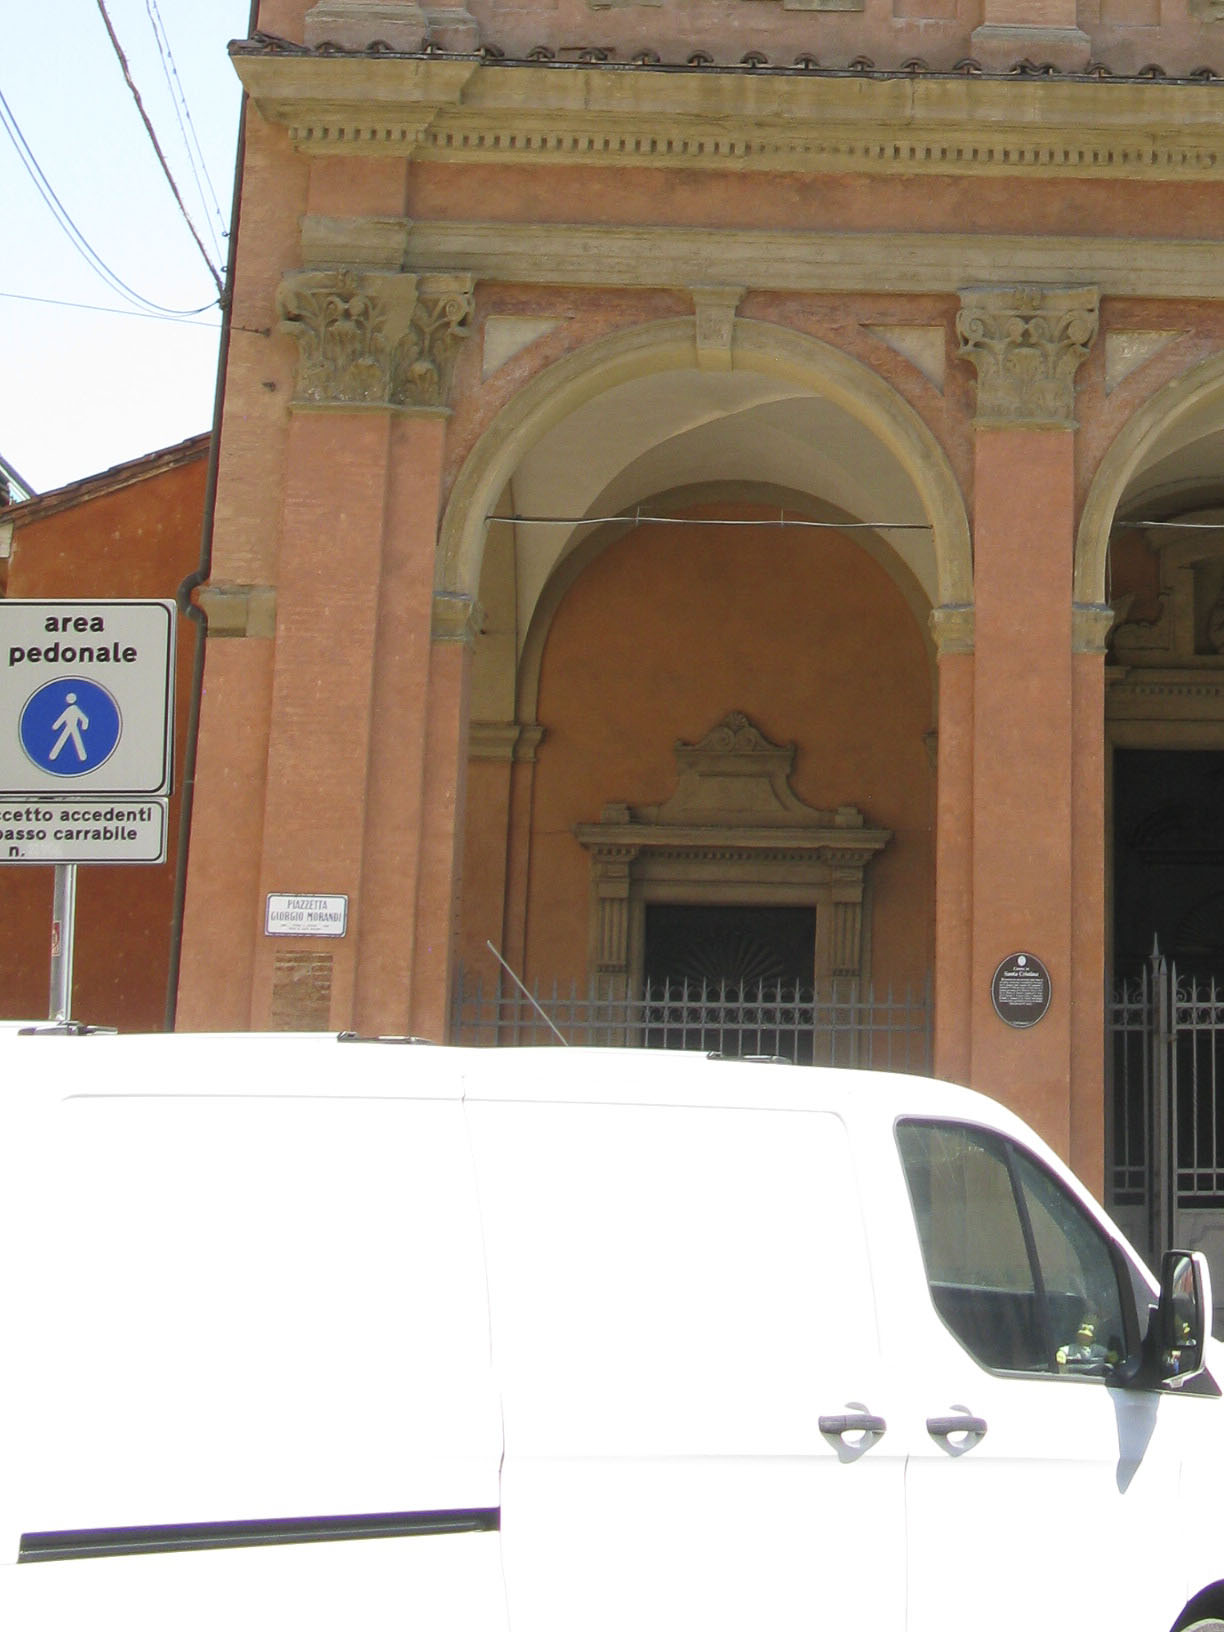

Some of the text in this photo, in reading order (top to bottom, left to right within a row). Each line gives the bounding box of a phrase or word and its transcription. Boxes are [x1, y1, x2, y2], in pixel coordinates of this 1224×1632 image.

[44, 616, 105, 633] area
[8, 642, 138, 667] pedonale
[0, 807, 153, 822] cetto accedenti
[0, 826, 138, 841] asso carrabile
[287, 899, 328, 910] PIAZZETTA
[270, 911, 342, 922] GIORGIO MORANDI
